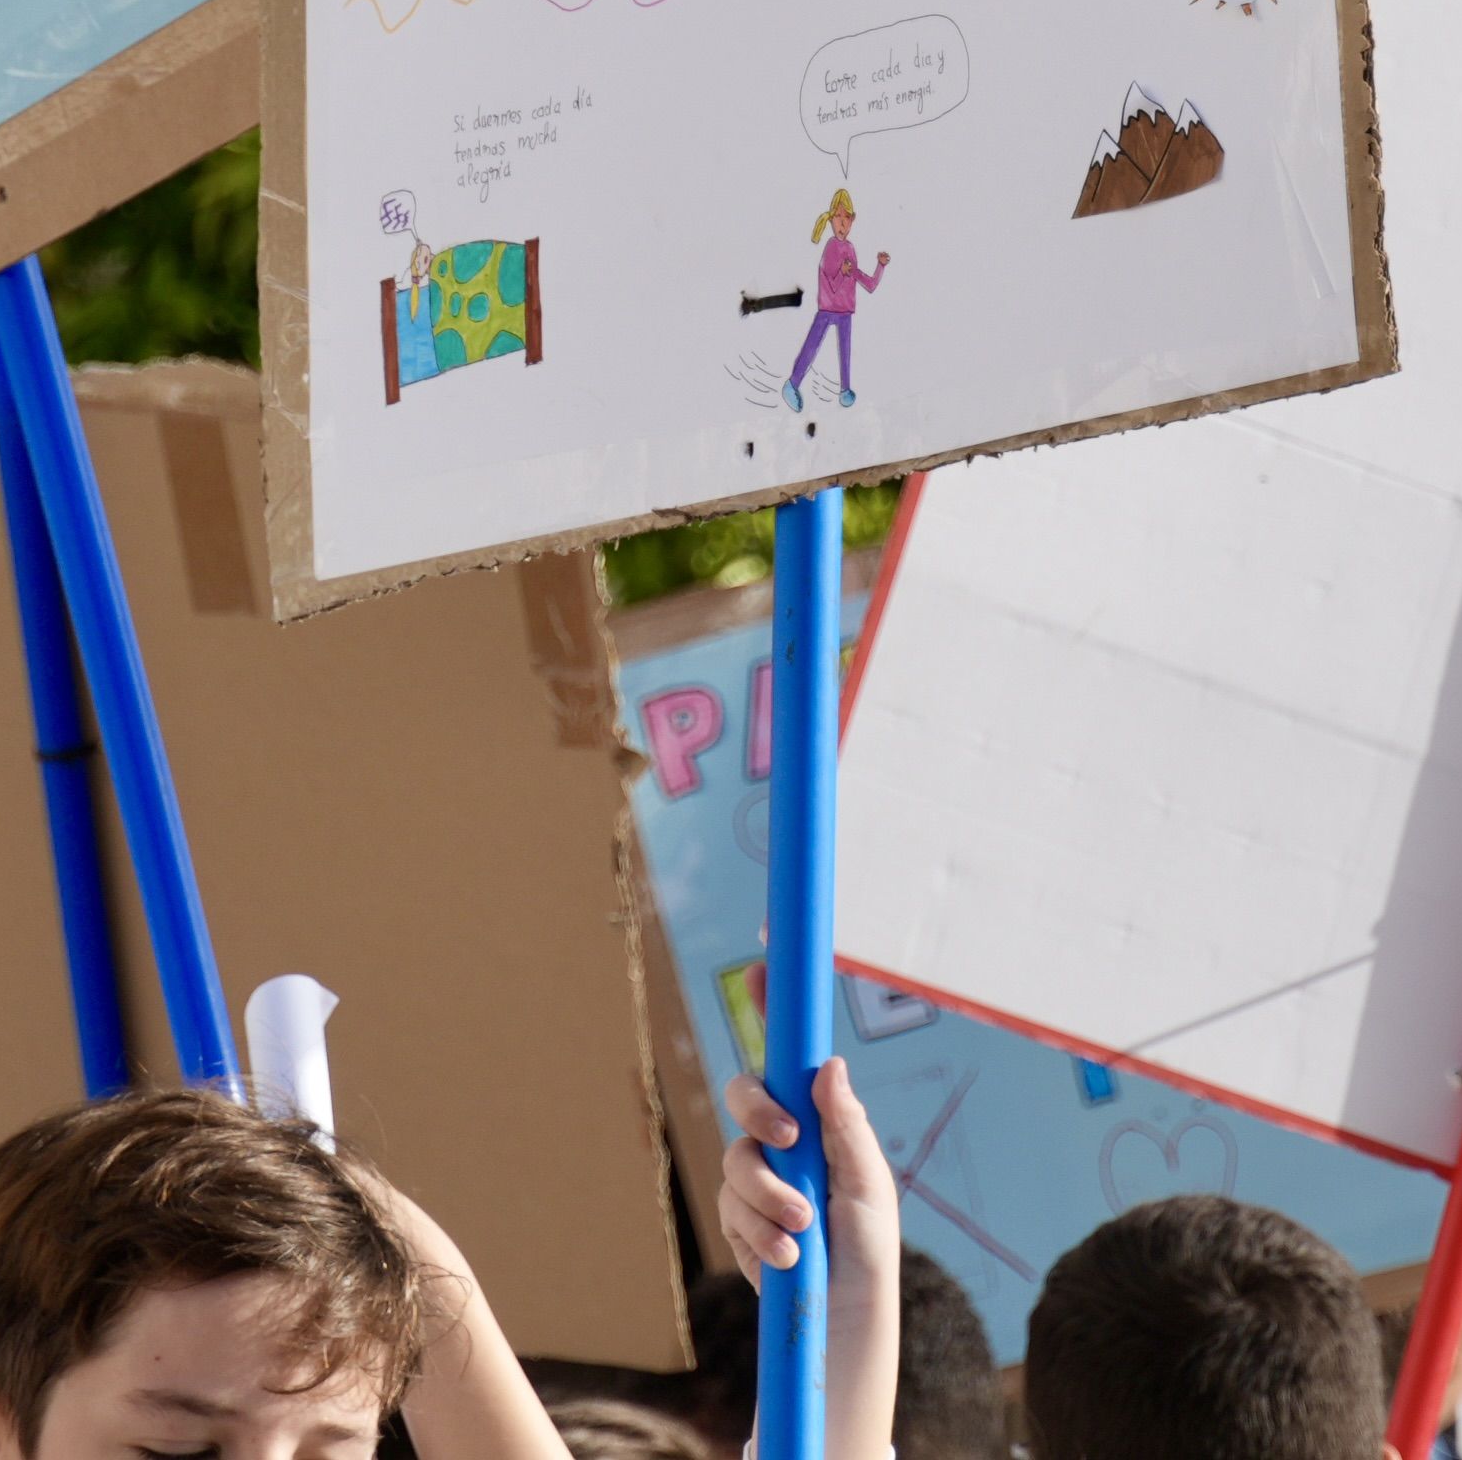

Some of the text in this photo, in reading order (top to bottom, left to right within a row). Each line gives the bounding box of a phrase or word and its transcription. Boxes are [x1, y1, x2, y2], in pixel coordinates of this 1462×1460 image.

[872, 48, 902, 83] cada
[937, 49, 945, 74] y
[531, 96, 562, 120] cada
[517, 121, 558, 151] mucha
